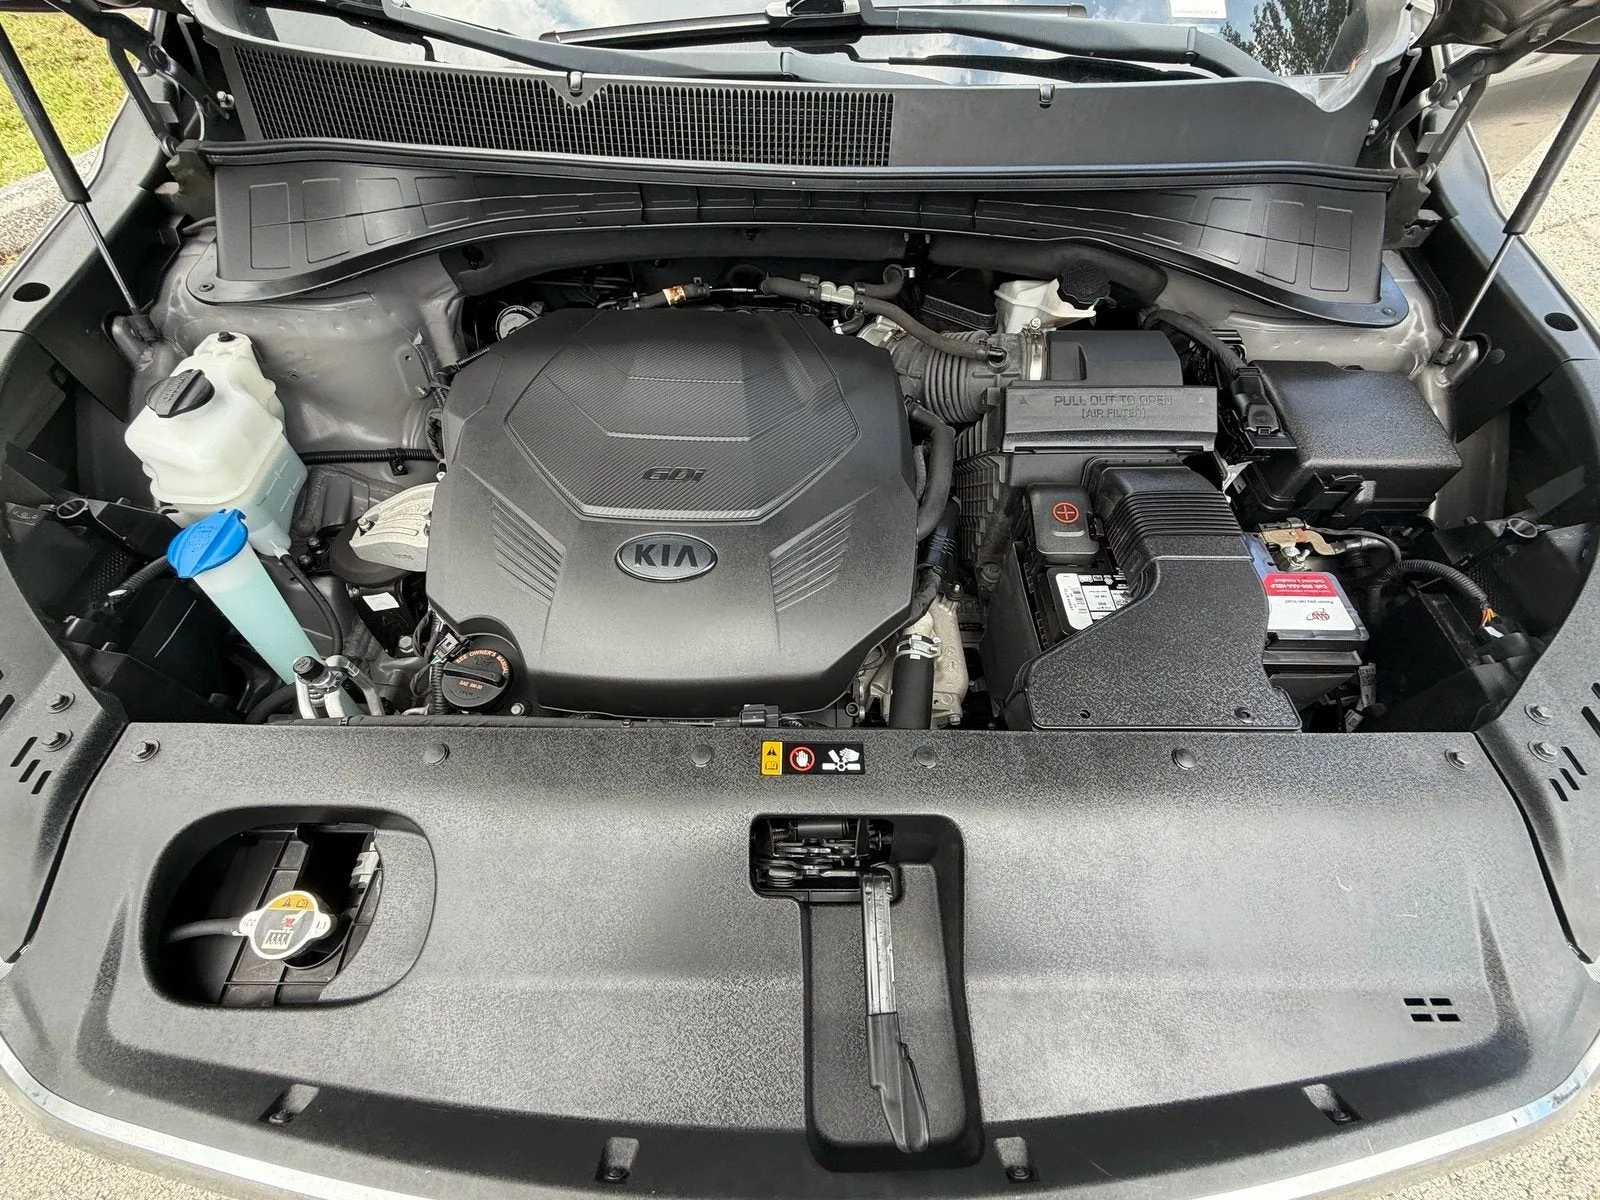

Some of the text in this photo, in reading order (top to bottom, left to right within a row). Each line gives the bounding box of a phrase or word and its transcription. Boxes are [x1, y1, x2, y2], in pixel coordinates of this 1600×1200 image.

[1054, 395, 1173, 406] PULL OUT TO OPEN
[634, 544, 699, 568] KIA
[456, 655, 468, 664] SEE
[497, 655, 509, 675] MANUAL
